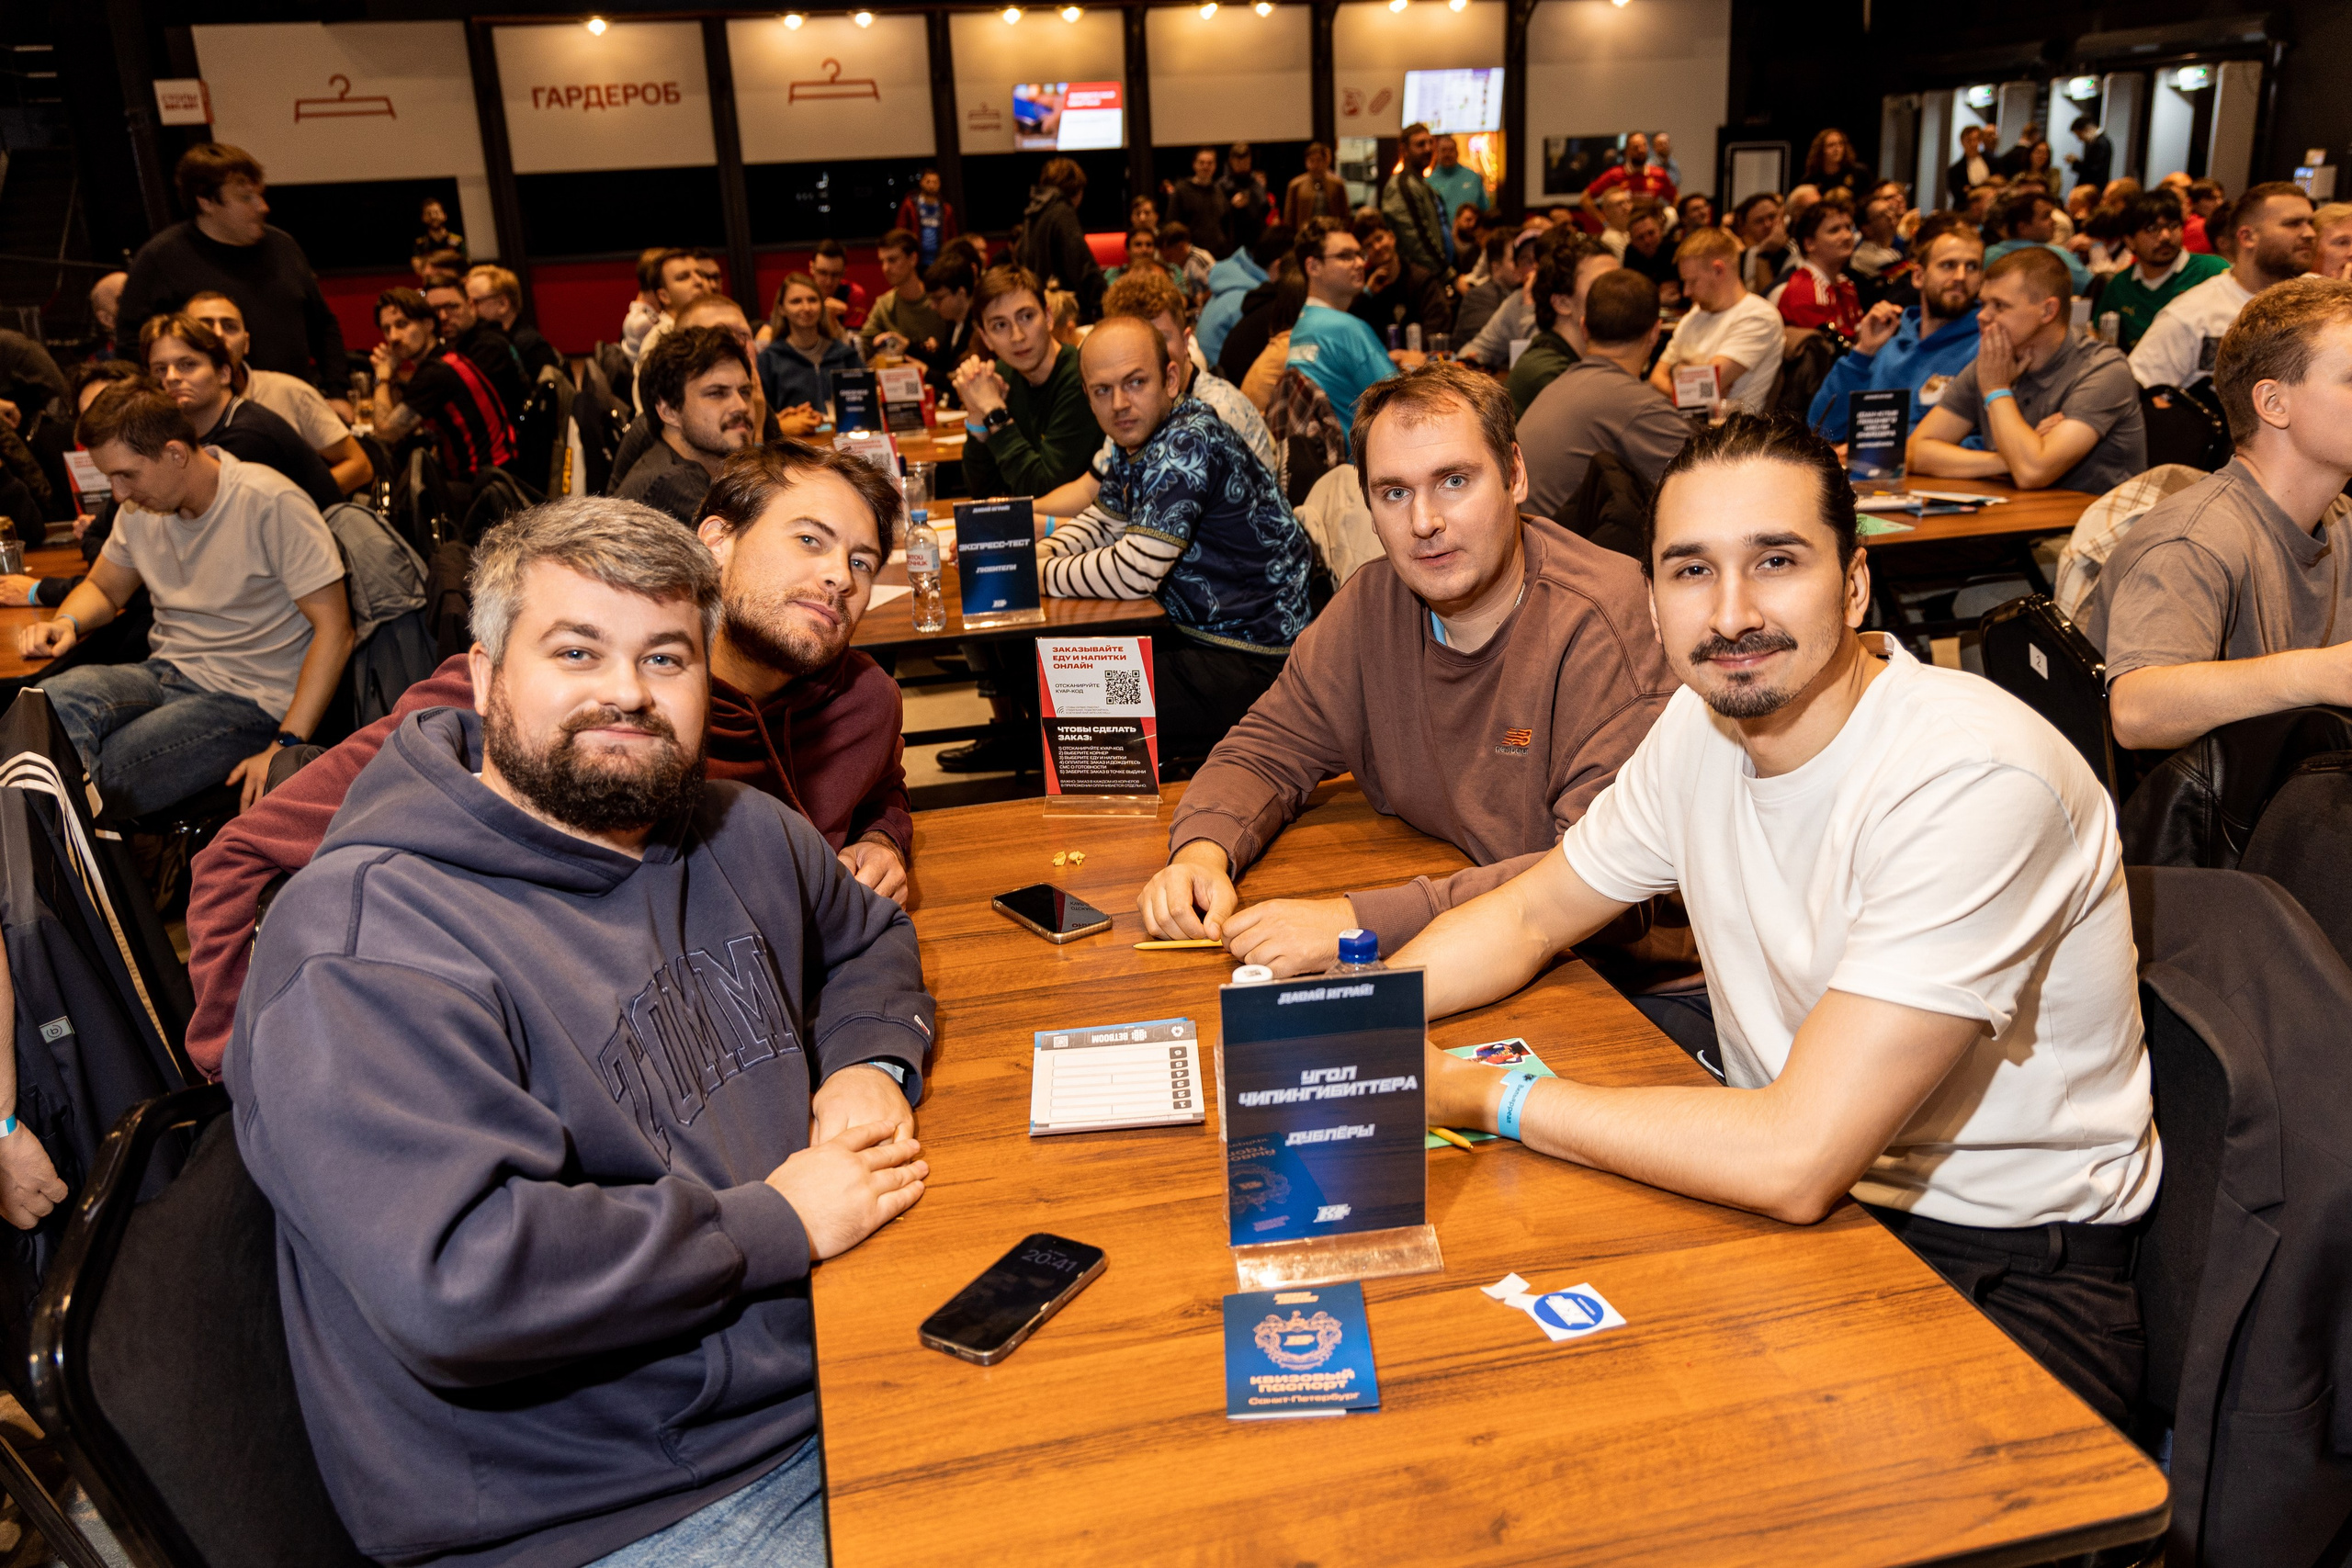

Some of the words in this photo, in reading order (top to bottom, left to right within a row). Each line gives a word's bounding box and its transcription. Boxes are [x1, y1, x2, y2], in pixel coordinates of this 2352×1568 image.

[531, 82, 681, 111] ГАРДЕРОБ
[958, 538, 1031, 551] ЭКСПРЕСС-ТЕСТ
[976, 564, 1017, 574] ЛЮБИТЕЛИ
[1277, 987, 1326, 1005] ДАВАЙ
[1327, 983, 1374, 1000] ИГРАЙ!
[1091, 1032, 1128, 1043] BETBOOM
[598, 932, 801, 1171] TOMM
[1300, 1066, 1358, 1086] УГОЛ
[1238, 1075, 1419, 1107] ЧИПИНГИБИТТЕРА
[1284, 1123, 1375, 1146] ДУБЛЁРЫ
[1022, 1249, 1078, 1272] 20:41
[1248, 1392, 1360, 1405] Санкт-Петербург
